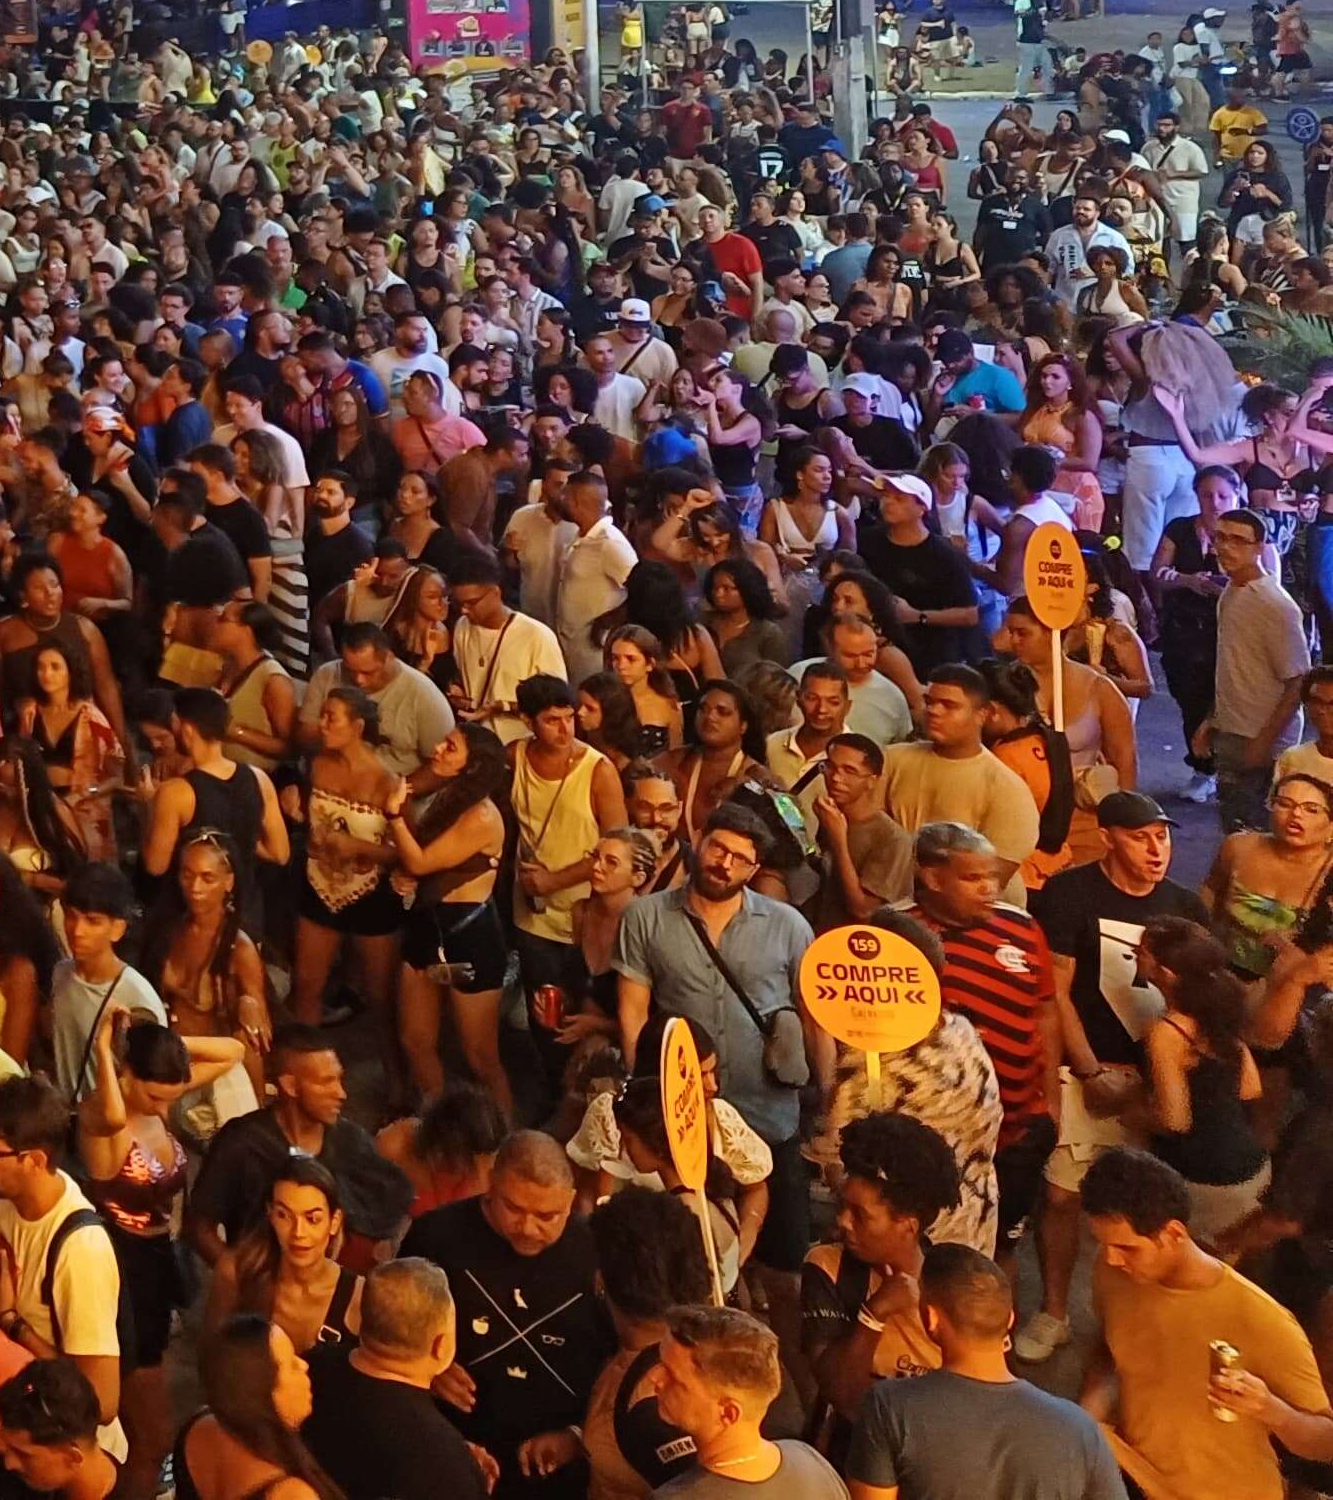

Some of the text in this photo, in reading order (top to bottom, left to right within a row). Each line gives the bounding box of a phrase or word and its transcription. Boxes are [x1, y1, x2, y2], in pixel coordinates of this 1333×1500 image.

[760, 160, 783, 179] 17
[1038, 561, 1073, 575] COMPRE
[851, 938, 878, 952] 159
[816, 962, 921, 984] COMPRE
[844, 985, 899, 1005] AQUI
